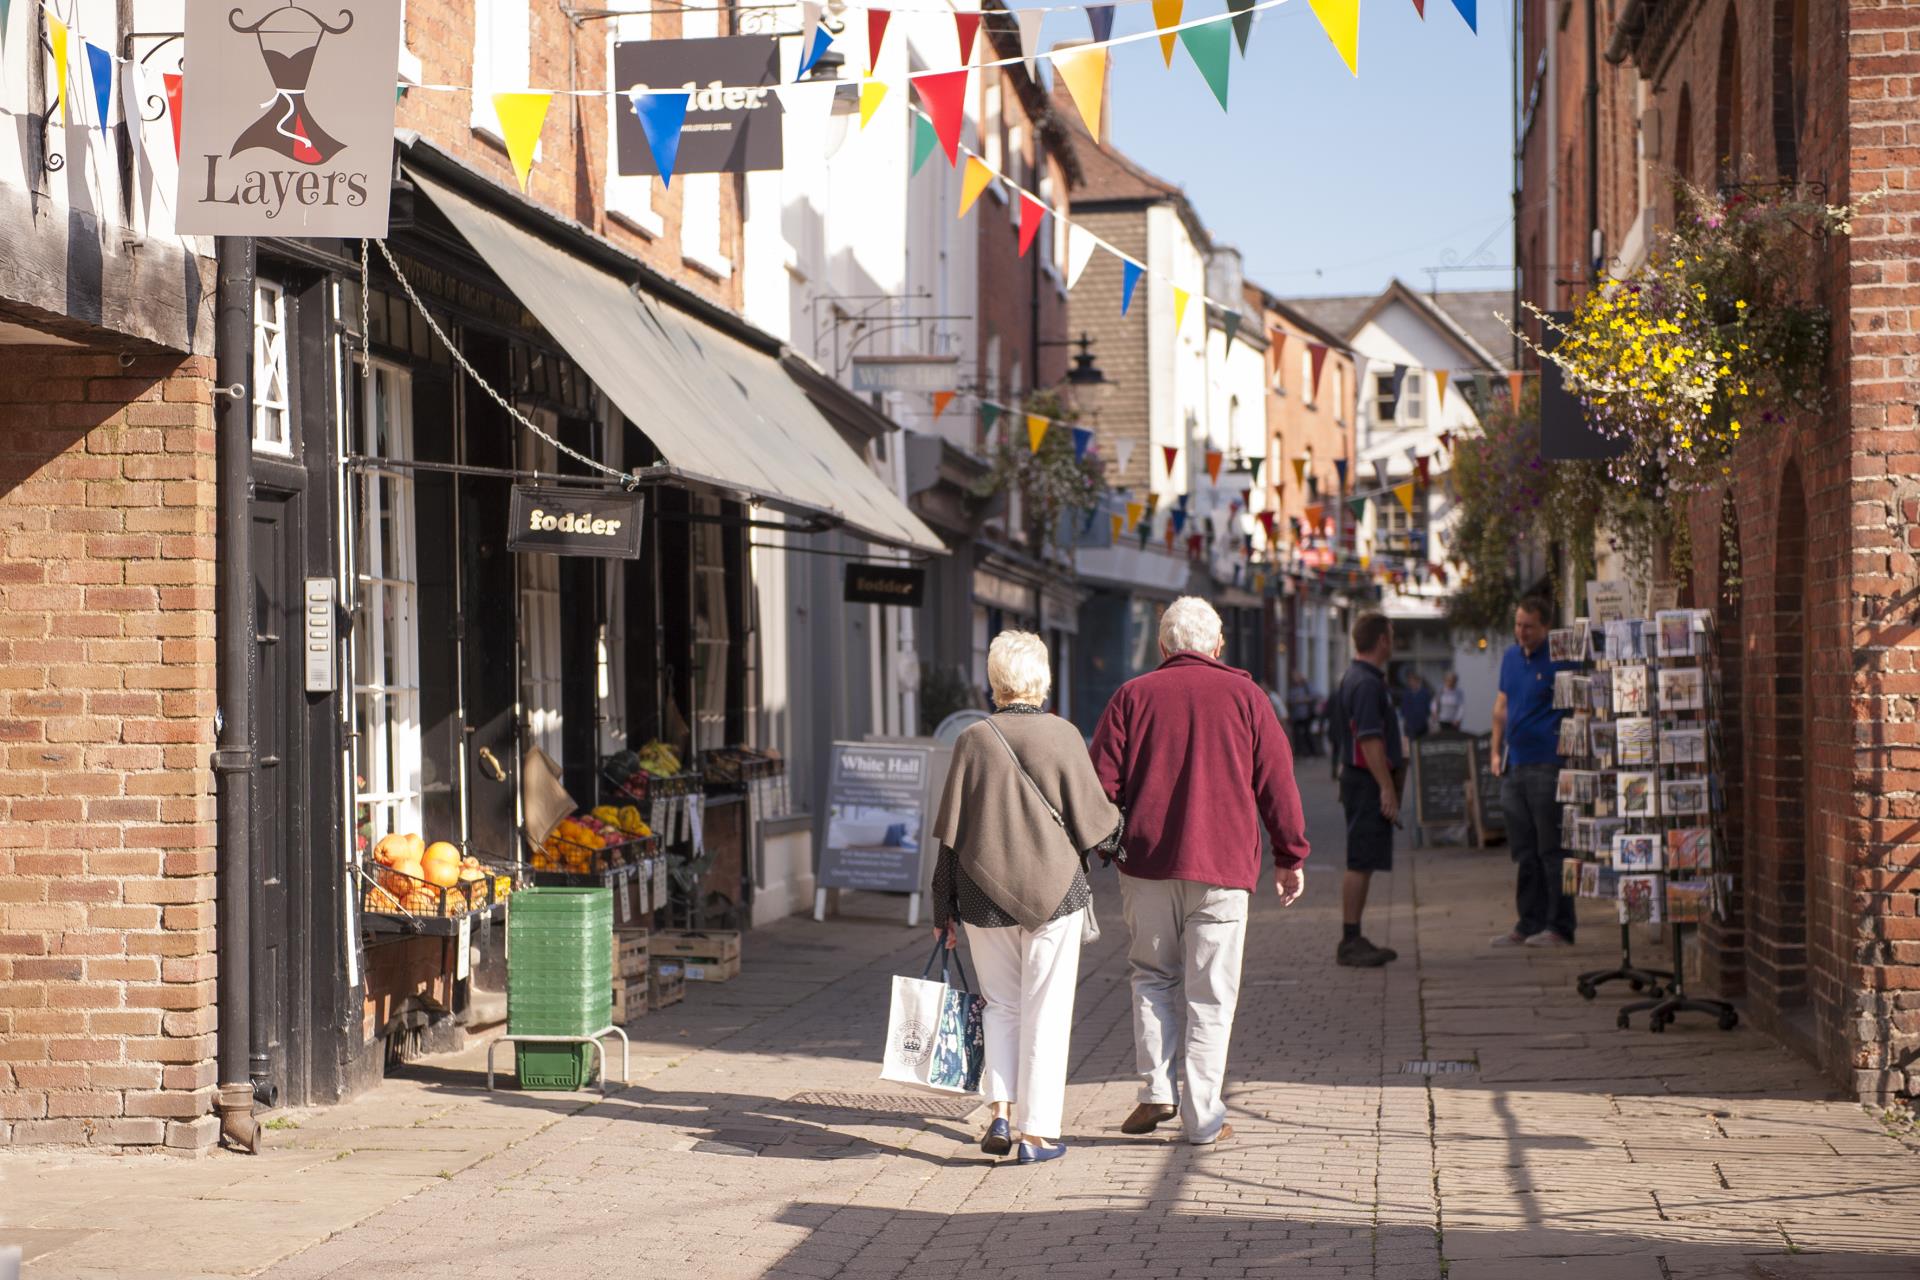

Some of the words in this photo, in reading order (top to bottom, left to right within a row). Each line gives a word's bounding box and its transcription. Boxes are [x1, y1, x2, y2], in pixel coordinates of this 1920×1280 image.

[629, 80, 766, 114] fdder
[198, 154, 368, 219] Layers
[529, 508, 622, 536] fodder
[840, 755, 885, 772] White
[887, 757, 919, 774] Hall
